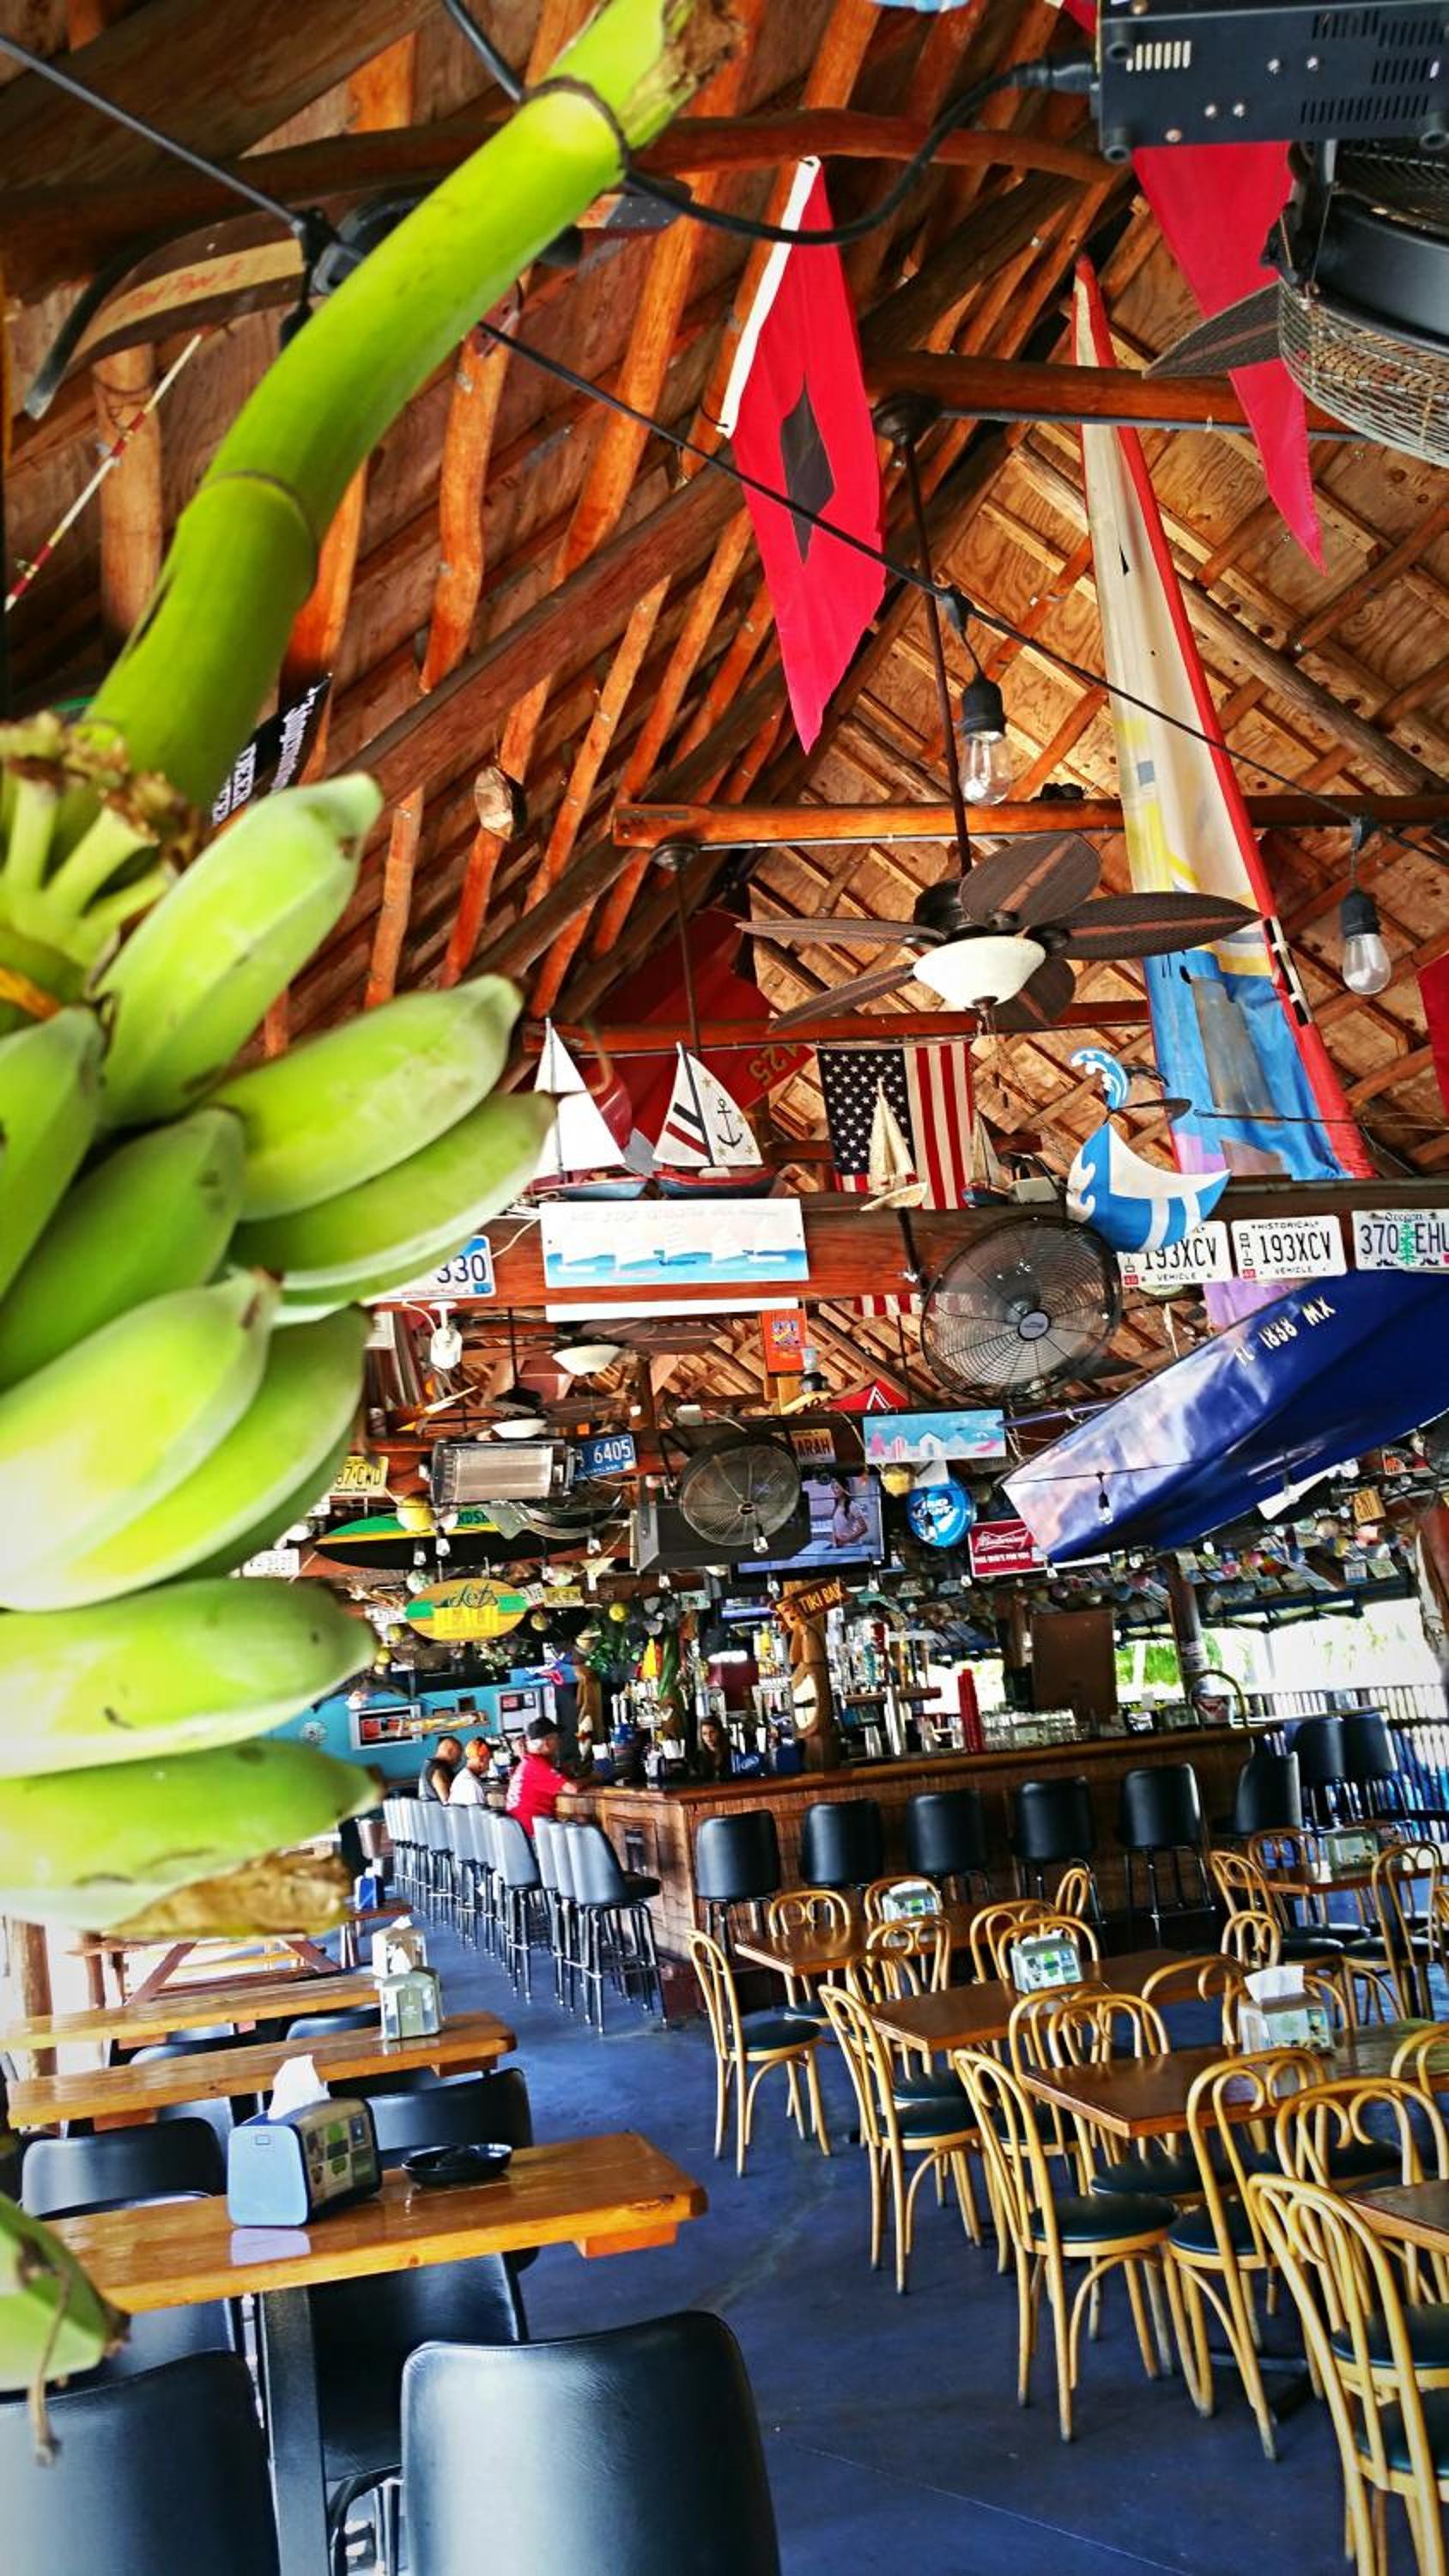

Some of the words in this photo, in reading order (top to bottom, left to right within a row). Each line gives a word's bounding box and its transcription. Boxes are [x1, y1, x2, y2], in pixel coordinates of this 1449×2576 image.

[1257, 1221, 1315, 1230] HISTORICAL
[1385, 1212, 1422, 1223] Oregon
[1145, 1237, 1216, 1270] 193XCV
[1259, 1230, 1331, 1264] 193XCV
[1359, 1224, 1399, 1255] 370
[1156, 1272, 1197, 1282] VEHICLE
[1274, 1266, 1313, 1275] VEHICLE
[1302, 1296, 1337, 1327] MX
[593, 1438, 632, 1464] 6405
[798, 1591, 823, 1613] TIKI
[821, 1581, 844, 1604] BAR
